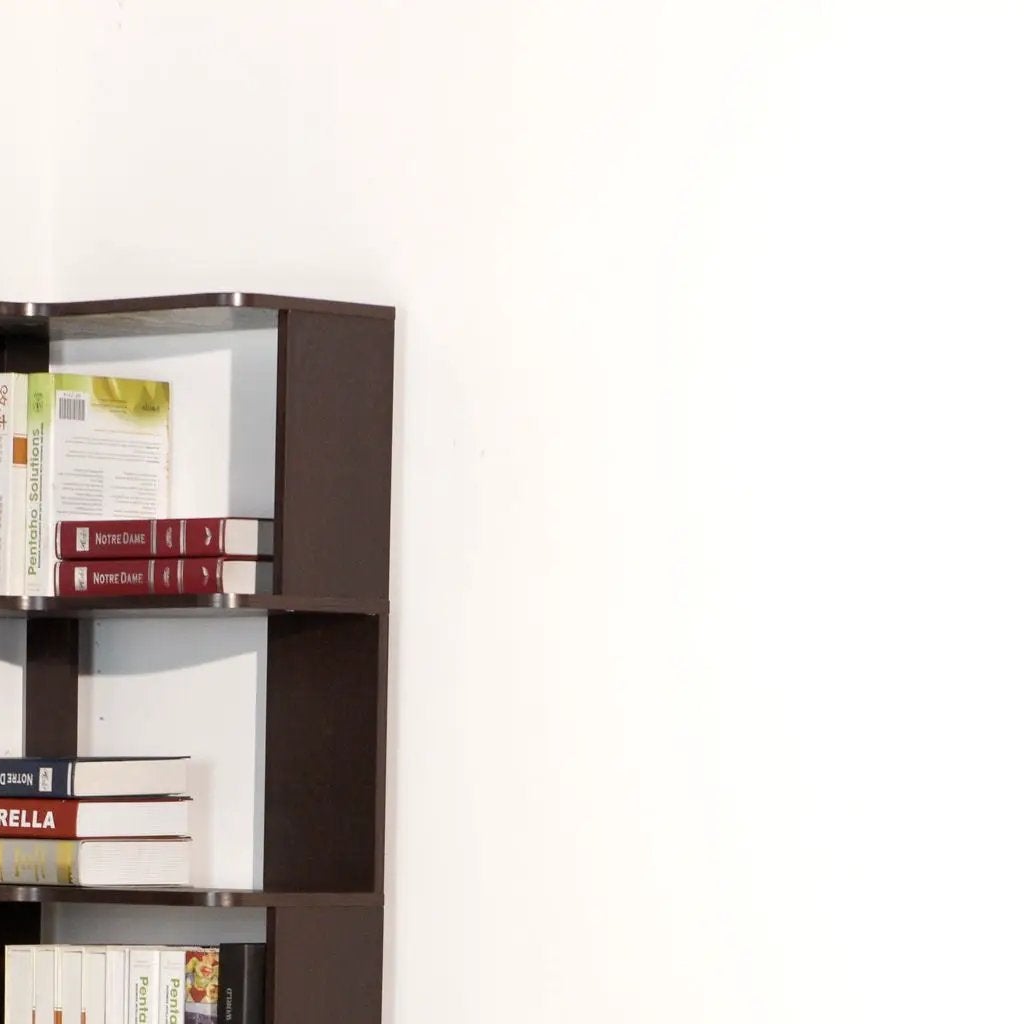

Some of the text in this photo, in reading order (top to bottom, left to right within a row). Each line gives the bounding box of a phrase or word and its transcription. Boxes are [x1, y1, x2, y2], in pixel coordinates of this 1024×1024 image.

[28, 428, 40, 575] Pentaho Solutions
[95, 532, 146, 545] NOTRE DAME
[93, 572, 143, 585] NOTRE DAME
[6, 772, 34, 786] NOTRE
